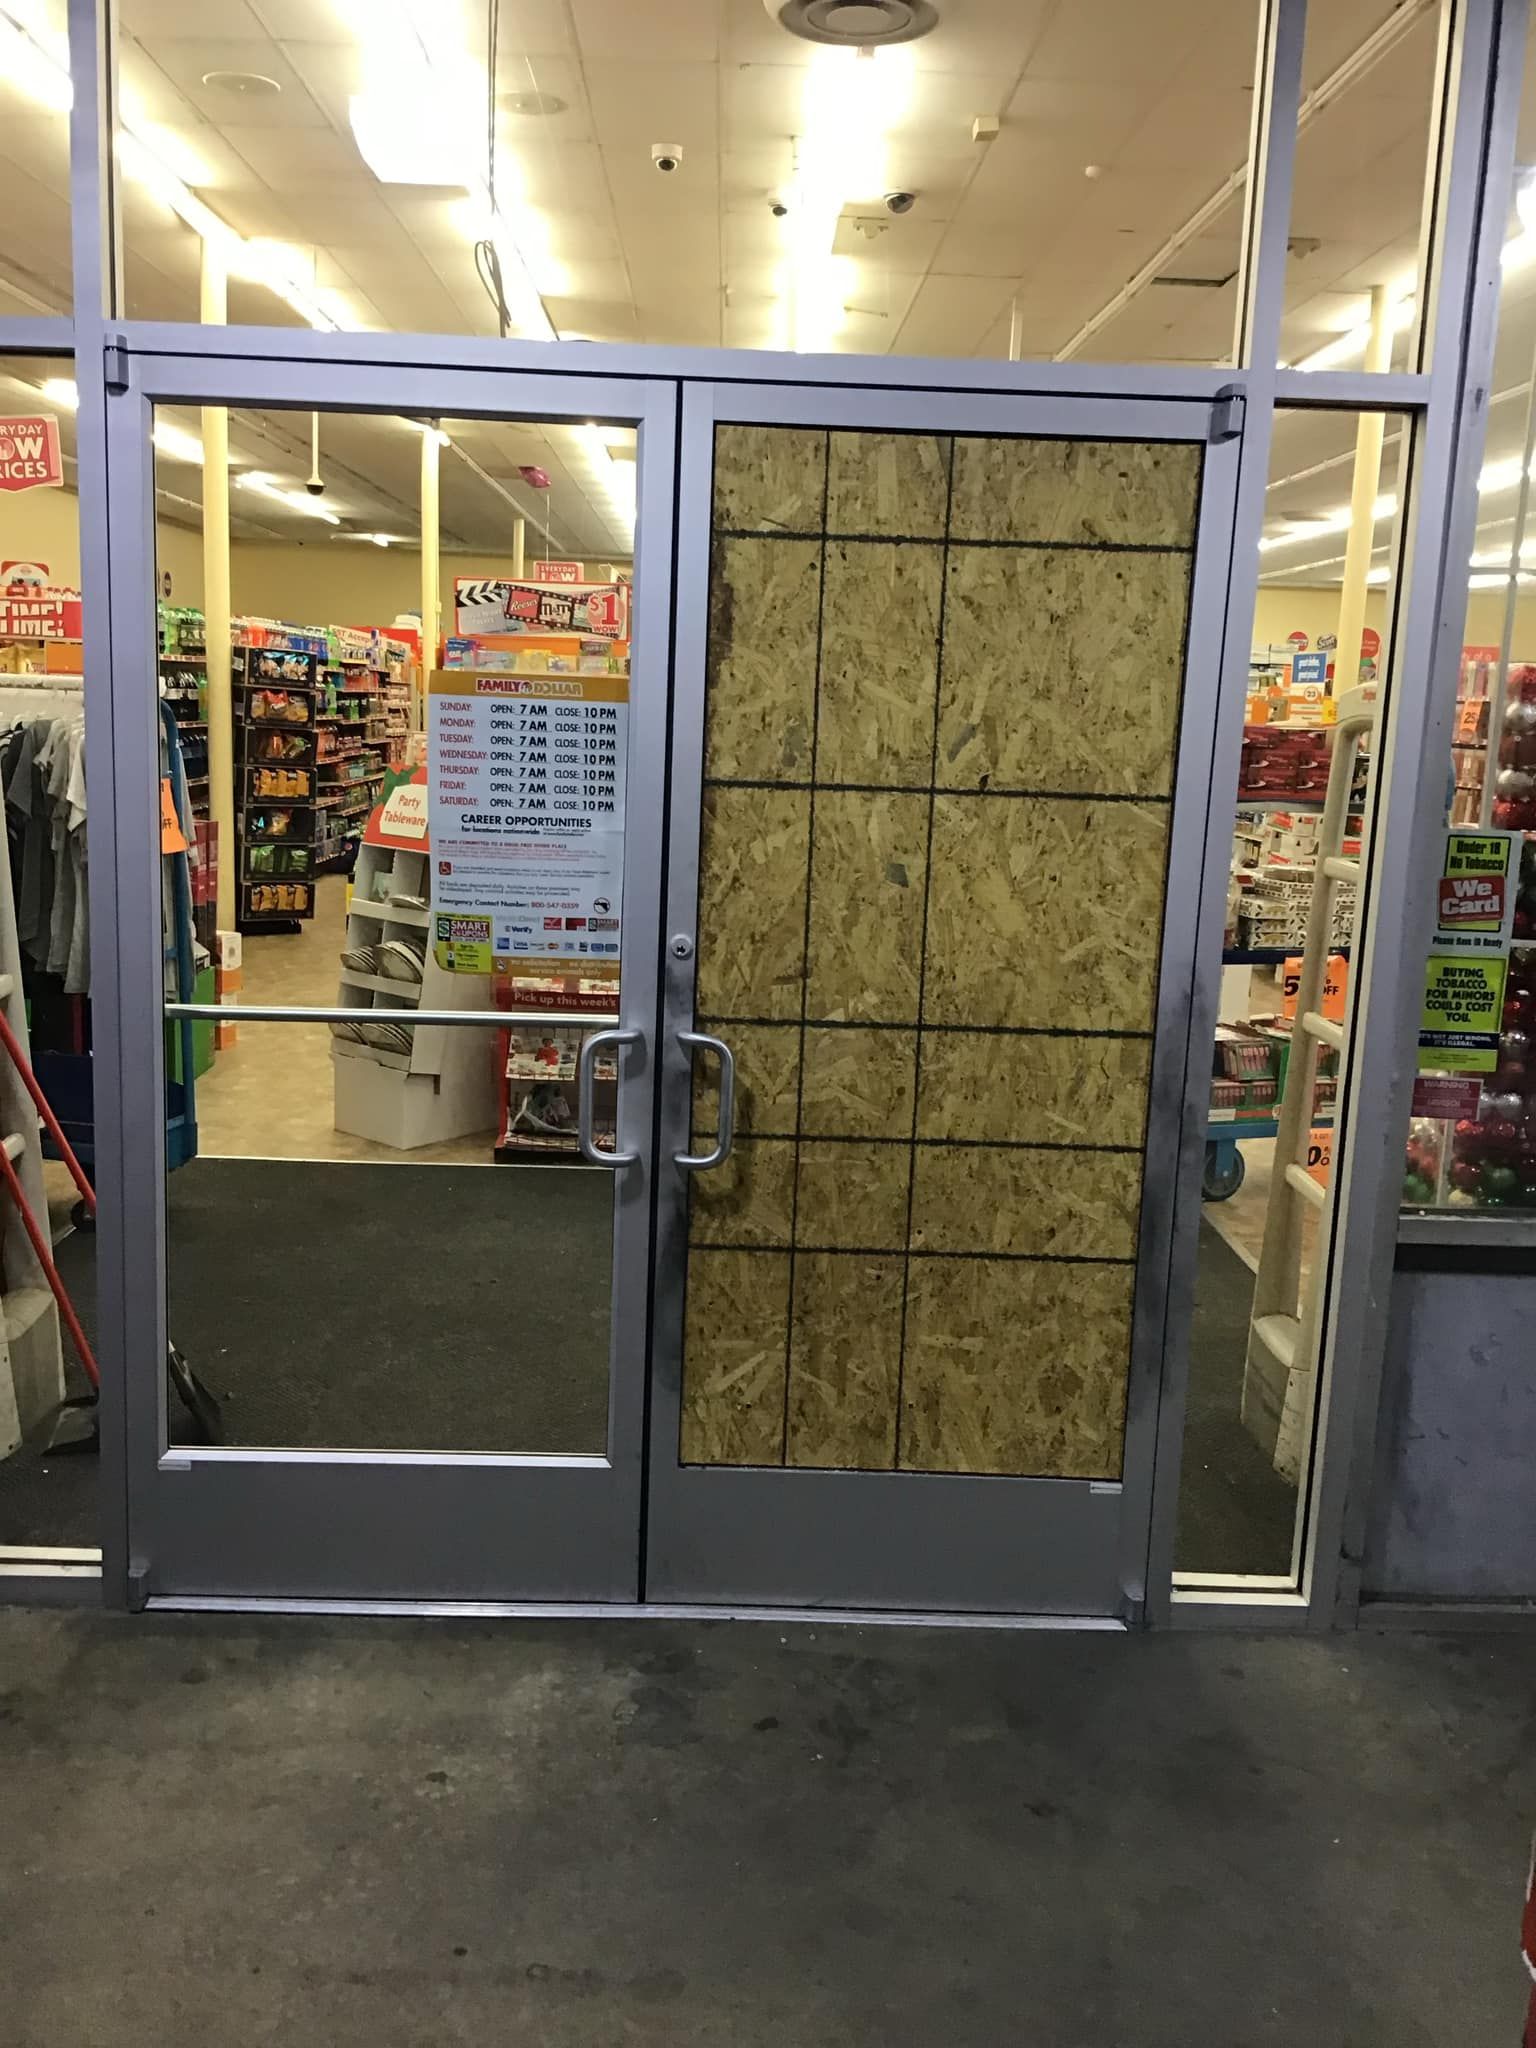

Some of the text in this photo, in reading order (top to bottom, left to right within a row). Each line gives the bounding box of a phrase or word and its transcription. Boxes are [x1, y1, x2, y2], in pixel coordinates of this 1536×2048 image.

[477, 679, 520, 693] FAMILY
[491, 705, 514, 714] OPEN:
[520, 705, 527, 714] 7
[530, 705, 547, 715] AM
[555, 707, 580, 717] CLOSE:
[584, 707, 597, 718] 10
[600, 708, 616, 719] PM
[490, 721, 514, 730] OPEN:
[520, 720, 527, 730] 7
[530, 721, 547, 731] AM
[555, 723, 580, 733] CLOSE:
[584, 723, 596, 733] 10
[600, 724, 616, 735] PM
[490, 736, 514, 745] OPEN:
[520, 736, 526, 746] 7
[529, 736, 547, 747] AM
[555, 739, 580, 749] CLOSE:
[584, 739, 596, 749] 10
[600, 740, 616, 751] PM
[490, 752, 514, 761] OPEN:
[519, 752, 526, 762] 7
[529, 752, 546, 763] AM
[555, 755, 580, 764] CLOSE:
[583, 754, 596, 765] 10
[599, 755, 615, 766] PM
[490, 768, 514, 777] OPEN:
[519, 767, 526, 777] 7
[529, 768, 546, 778] AM
[554, 770, 579, 779] CLOSE:
[583, 769, 595, 780] 10
[599, 770, 615, 781] PM
[490, 783, 514, 792] OPEN:
[519, 783, 525, 793] 7
[529, 783, 546, 794] AM
[554, 785, 579, 794] CLOSE:
[583, 785, 595, 795] 10
[599, 786, 615, 797] PM
[399, 794, 421, 810] Party
[490, 799, 514, 808] OPEN:
[519, 799, 525, 808] 7
[528, 799, 546, 809] AM
[554, 801, 579, 810] CLOSE:
[583, 801, 595, 811] 10
[598, 801, 615, 812] PM
[384, 811, 426, 827] Tableware
[461, 814, 592, 828] CAREER OPPORTUNITIES
[1456, 840, 1501, 855] Under 18
[1450, 856, 1504, 870] No Tobacco
[1453, 880, 1493, 897] We
[439, 897, 473, 906] Emergency
[1442, 895, 1500, 915] Card
[451, 920, 489, 931] SMART
[451, 930, 489, 938] COUPONS
[1443, 967, 1484, 978] BUYING
[1436, 978, 1487, 989] TOBACCO
[514, 992, 537, 1002] Pick
[540, 997, 554, 1008] up
[557, 994, 577, 1006] this
[1426, 989, 1495, 1001] FOR MINORS
[1426, 1000, 1493, 1012] COULD COST
[1446, 1012, 1471, 1022] YOU.
[1424, 1080, 1469, 1089] WARNING
